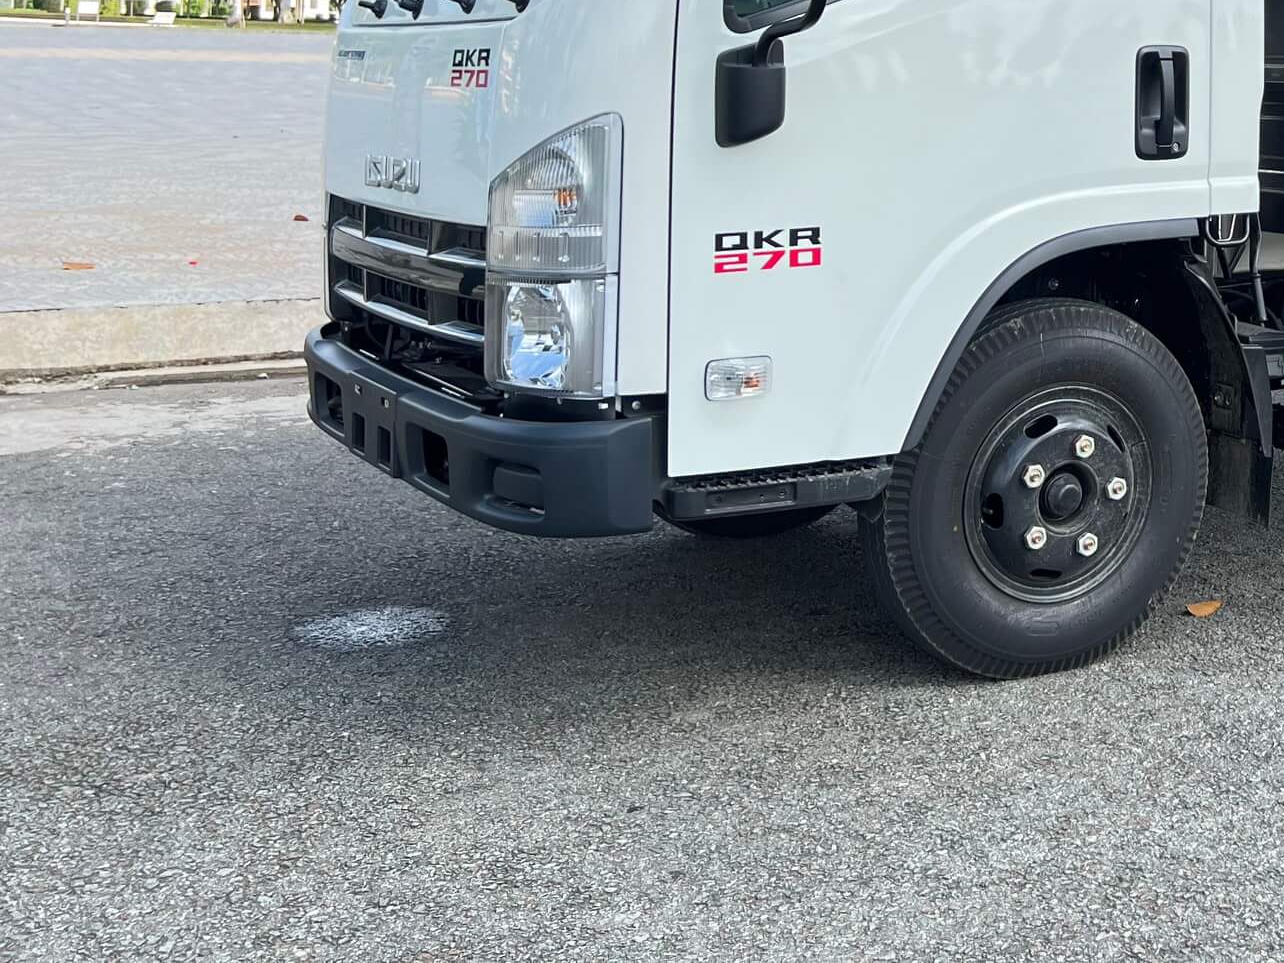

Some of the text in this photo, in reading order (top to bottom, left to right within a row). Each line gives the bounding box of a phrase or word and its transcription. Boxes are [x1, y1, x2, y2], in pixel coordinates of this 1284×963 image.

[452, 48, 491, 68] QKR
[450, 69, 489, 88] 270
[364, 154, 421, 194] ISUZU
[714, 226, 822, 252] QKR
[713, 247, 822, 274] 270
